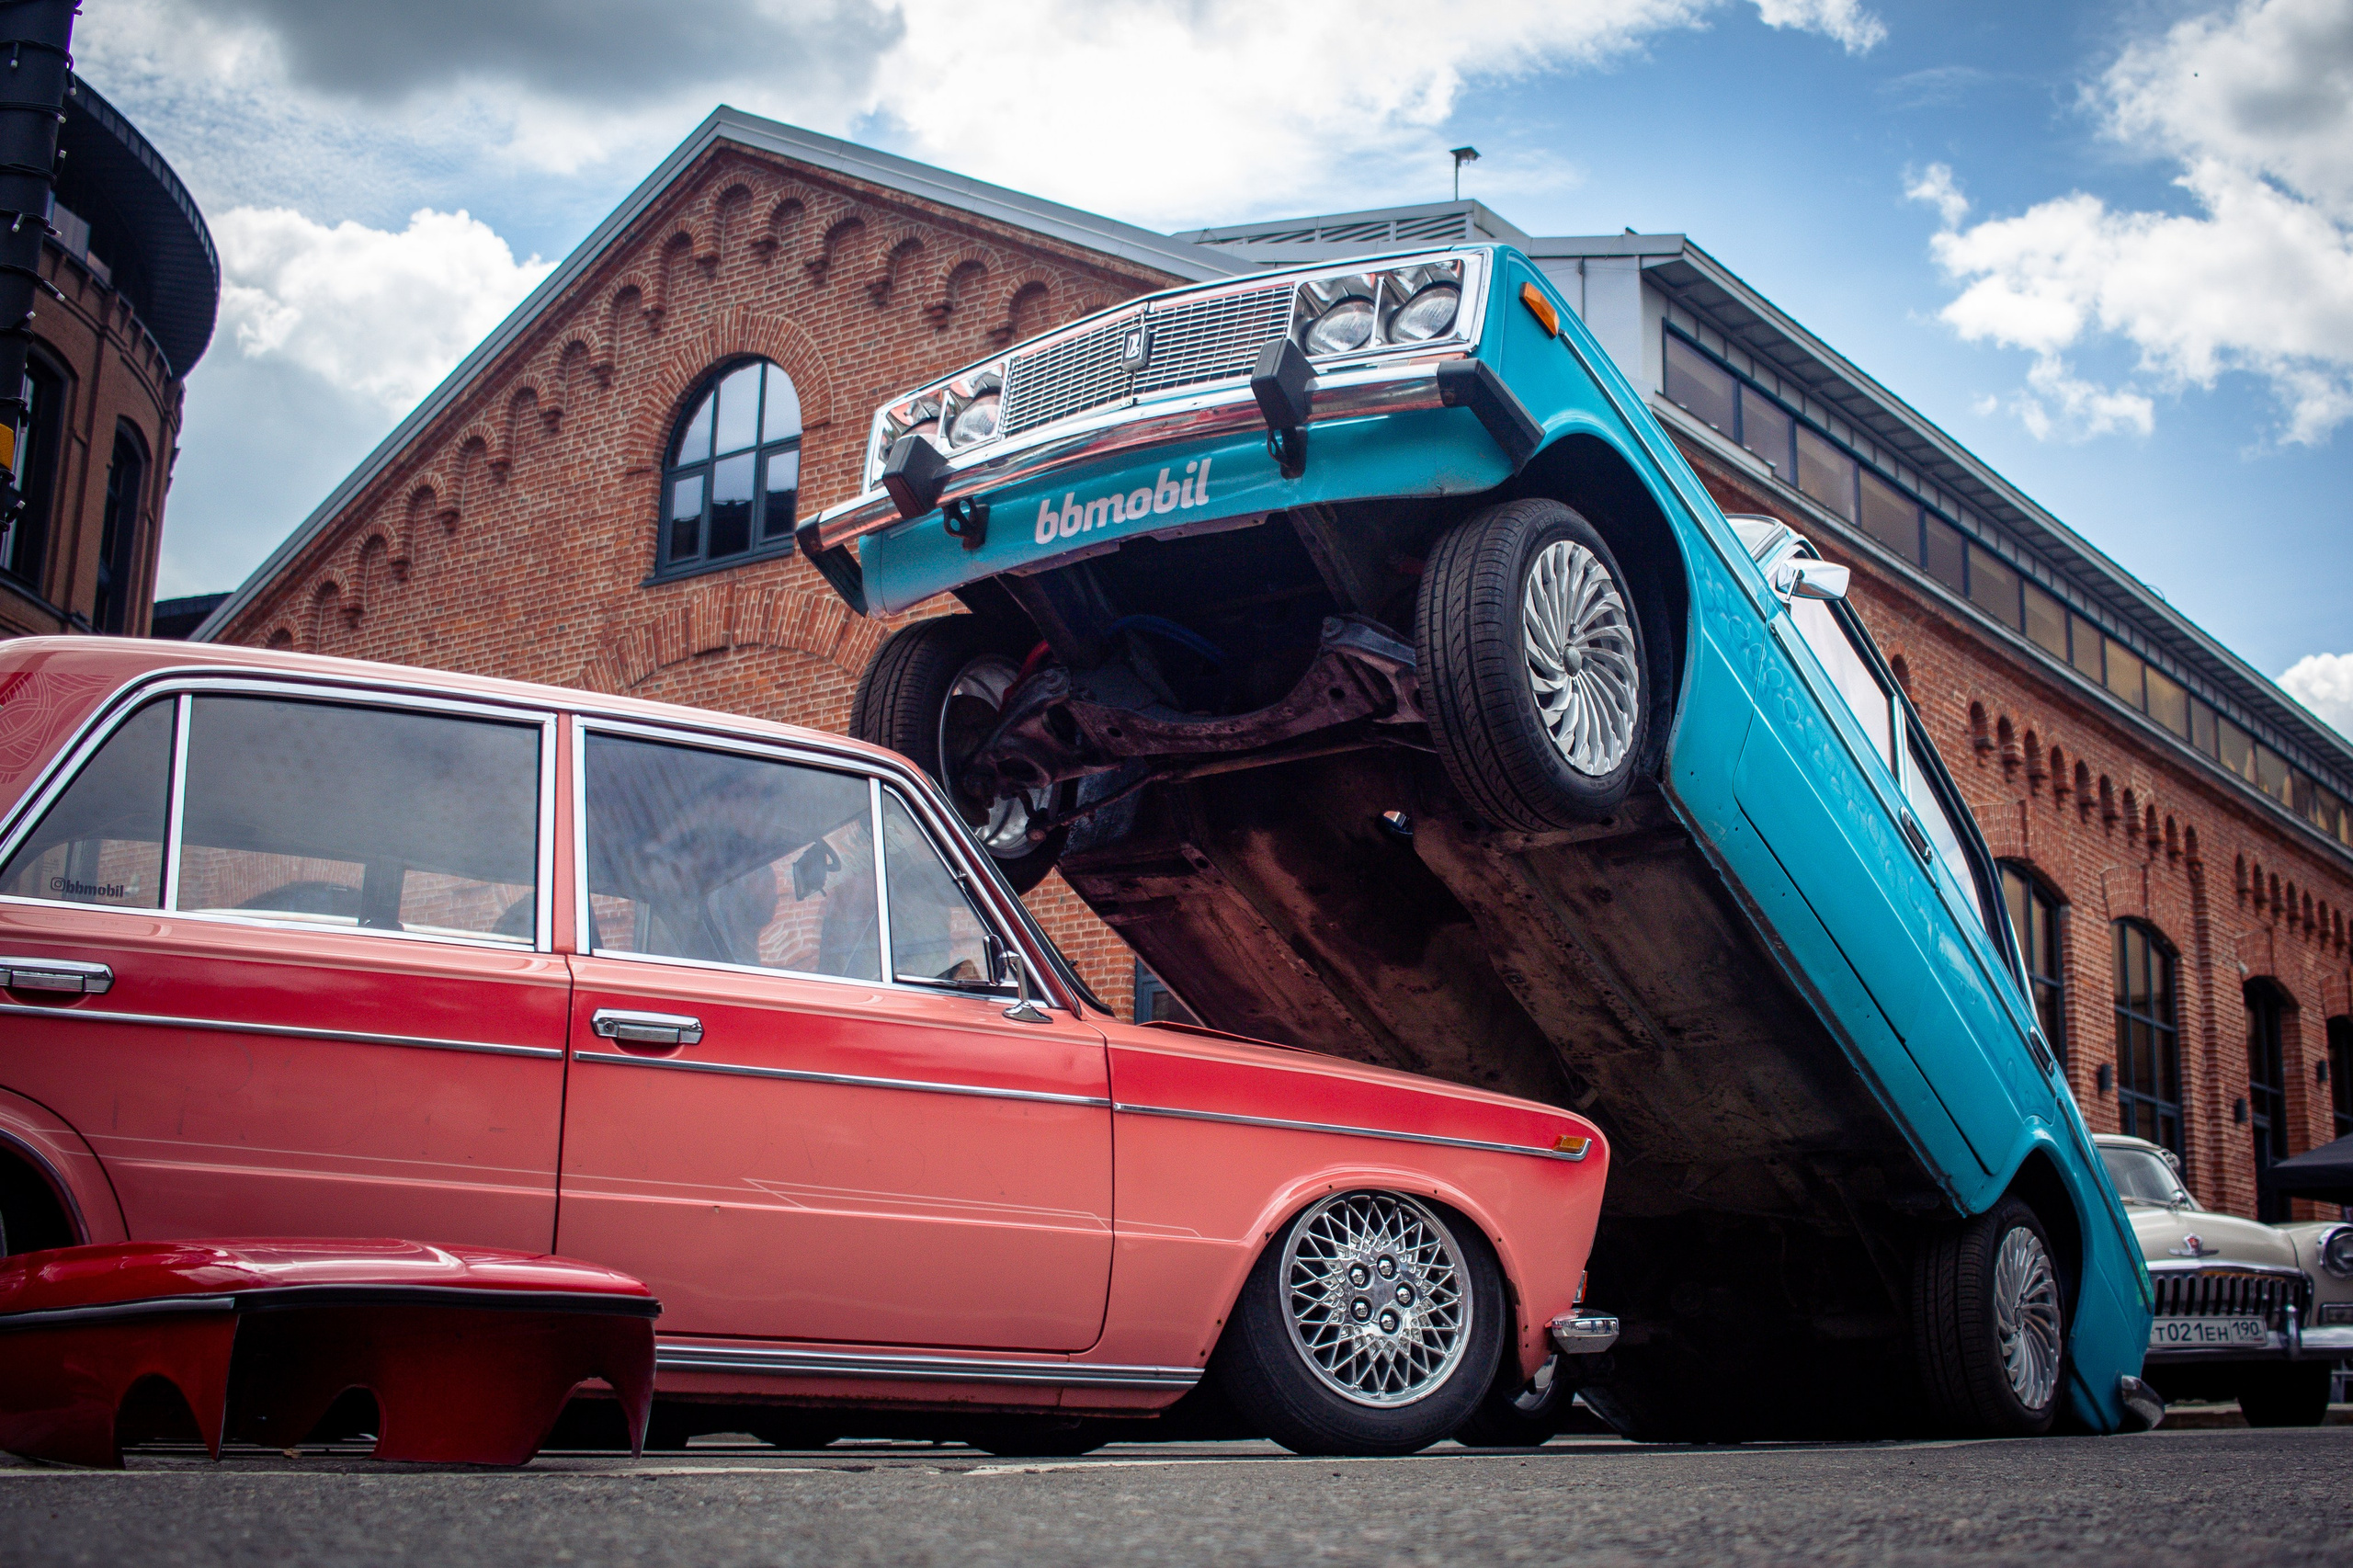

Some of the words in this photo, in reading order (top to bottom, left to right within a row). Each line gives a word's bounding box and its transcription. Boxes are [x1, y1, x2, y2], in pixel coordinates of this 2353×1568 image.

[1035, 458, 1212, 544] bbmobil
[66, 880, 124, 898] bbmobil
[2233, 1321, 2260, 1336] 190
